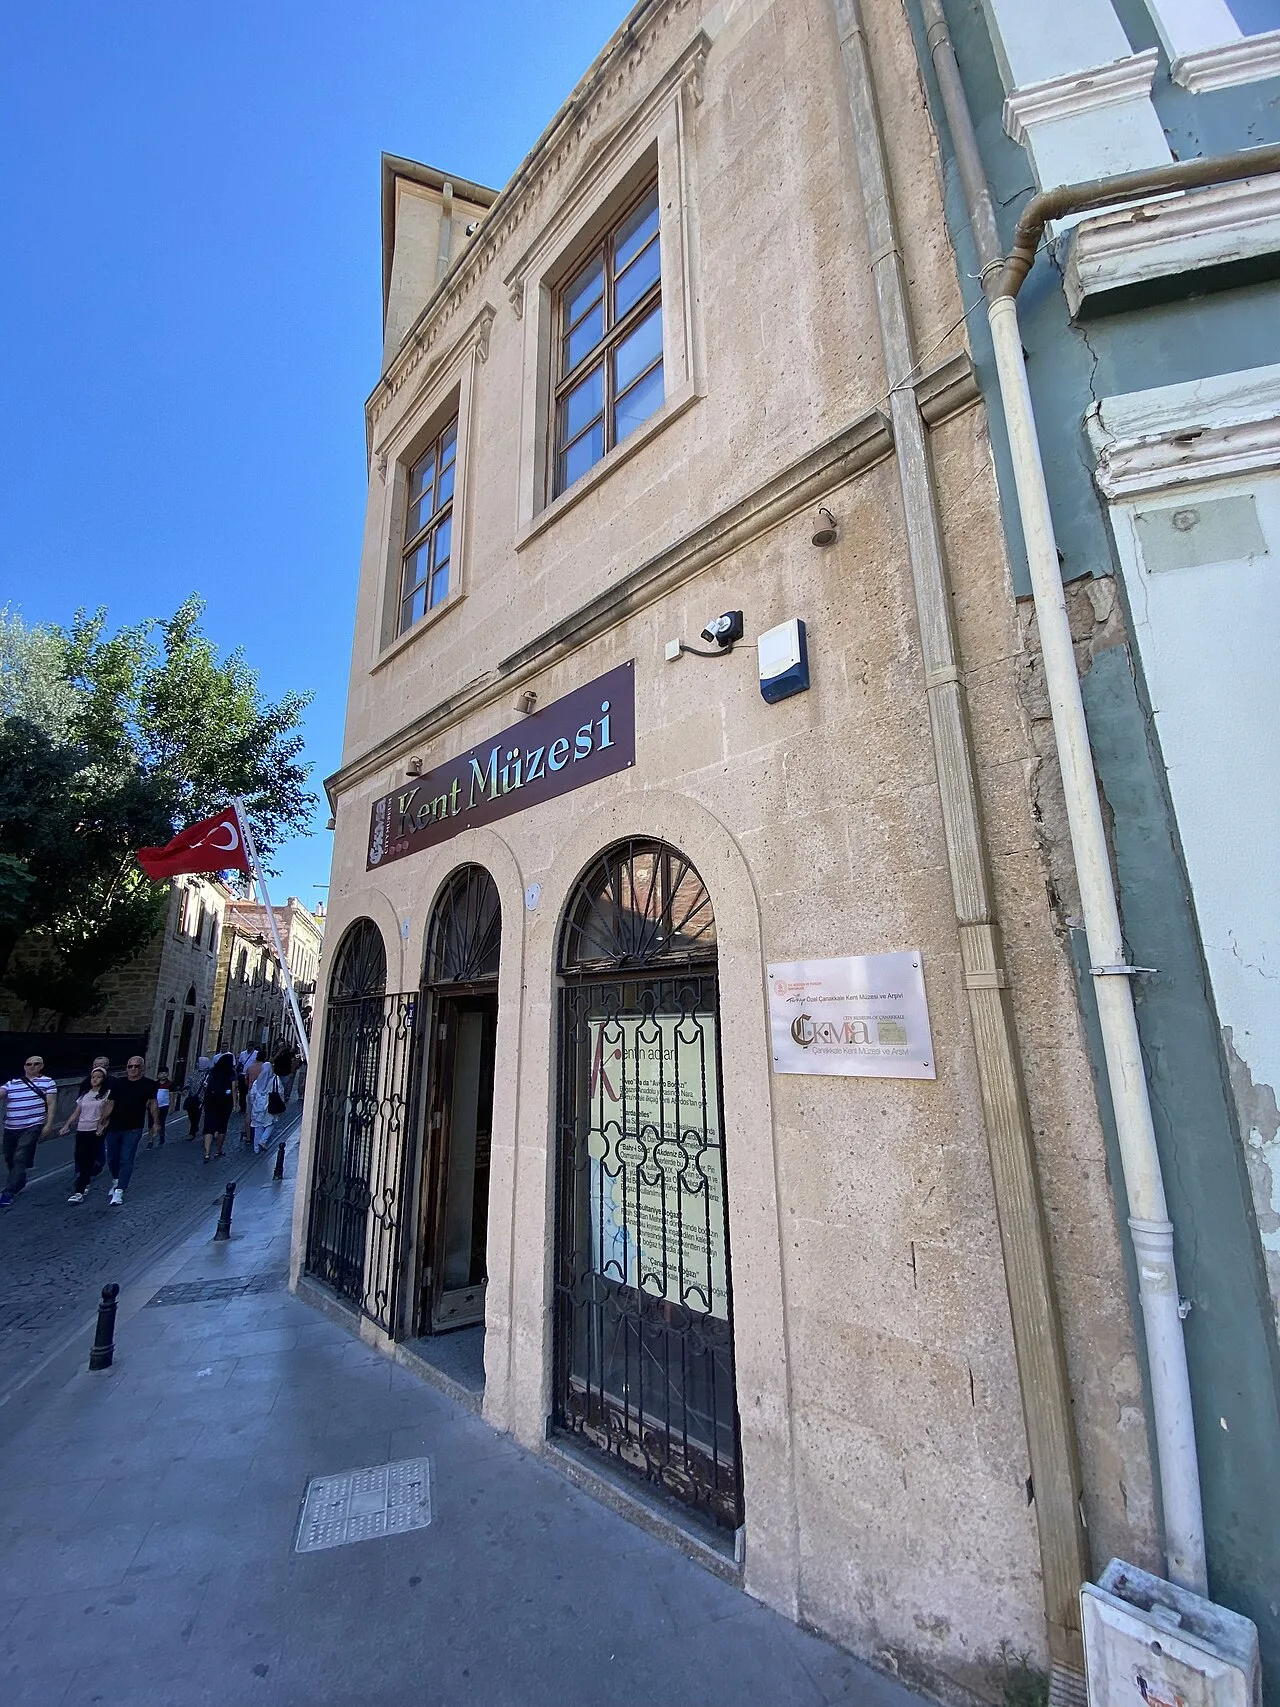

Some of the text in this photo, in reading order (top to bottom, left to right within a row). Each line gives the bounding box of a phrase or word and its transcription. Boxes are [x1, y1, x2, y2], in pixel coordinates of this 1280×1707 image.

[395, 701, 614, 840] Kent Müzesi
[859, 993, 879, 1001] Müzesi
[887, 992, 904, 1001] Arşivi
[812, 1047, 843, 1055] Çanakkale
[843, 1046, 858, 1054] Kent
[891, 1048, 909, 1056] Arşivi
